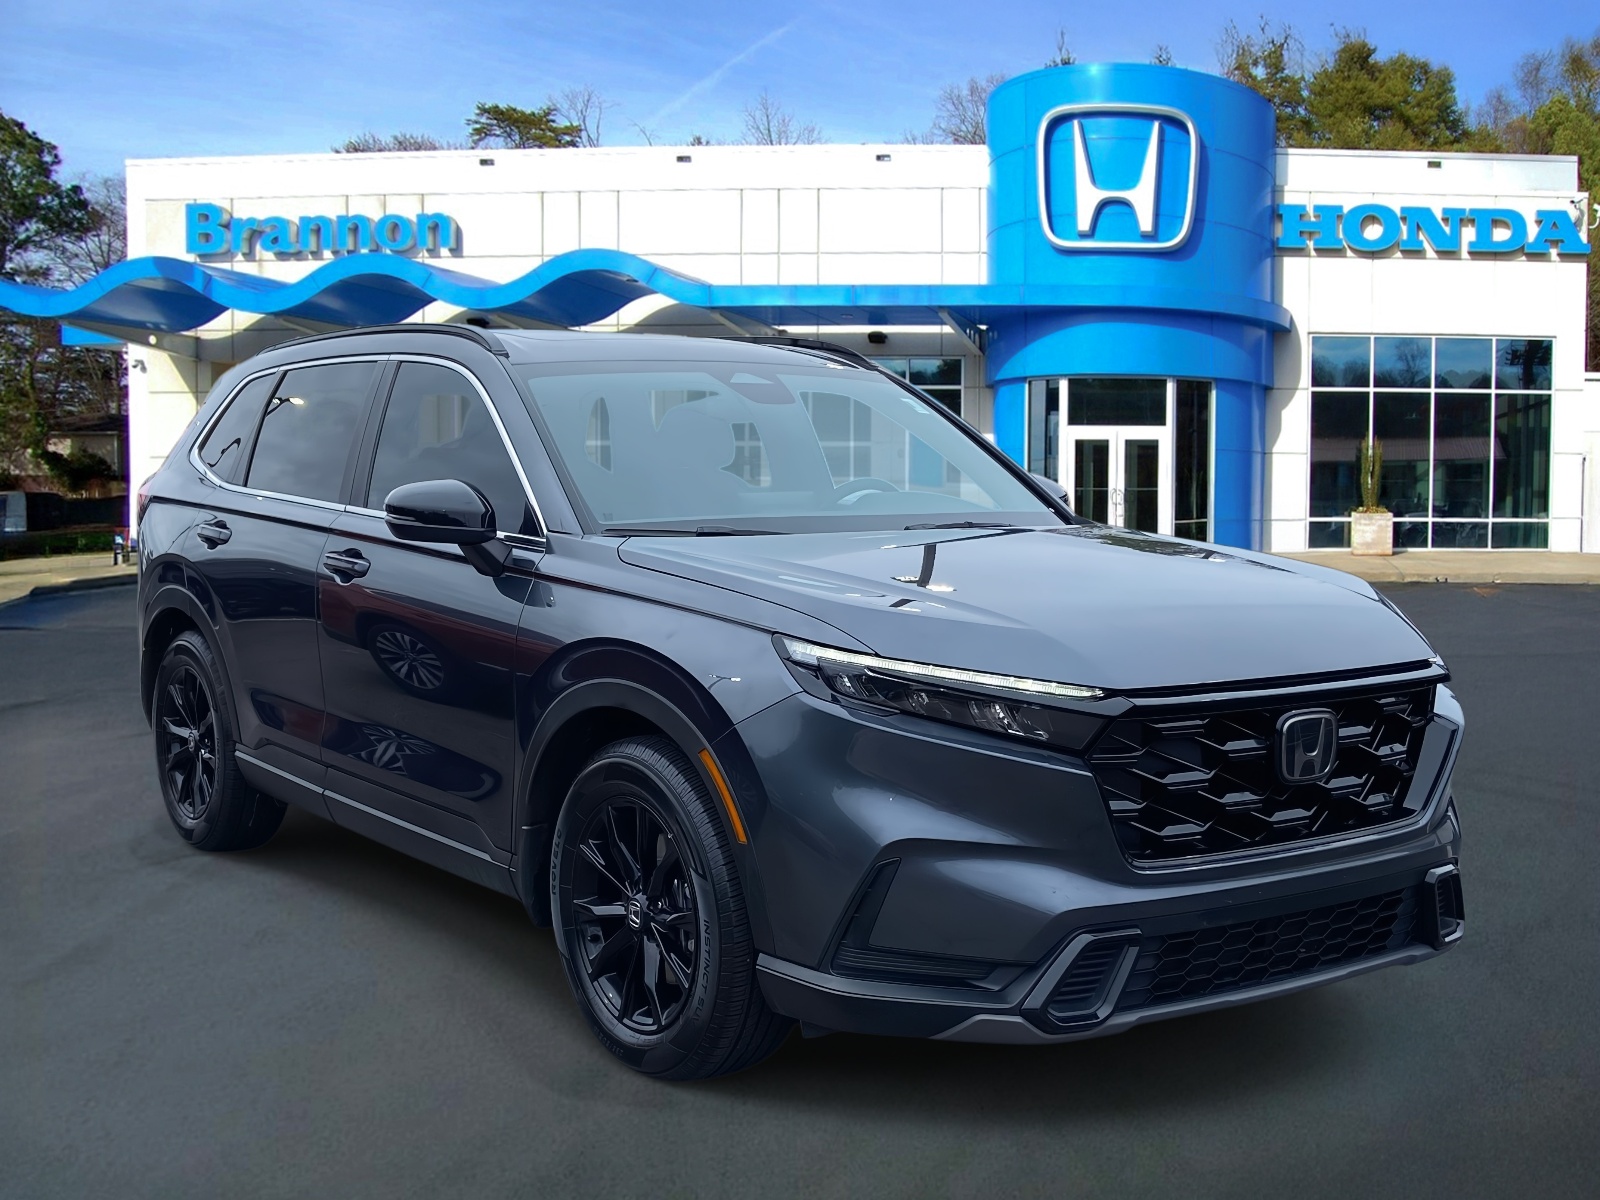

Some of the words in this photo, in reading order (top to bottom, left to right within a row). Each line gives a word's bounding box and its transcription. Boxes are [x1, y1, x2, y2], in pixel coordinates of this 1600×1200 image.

[185, 202, 458, 254] Brannon
[1276, 203, 1591, 254] HONDA
[551, 827, 563, 896] ROVELO
[702, 919, 711, 995] INSTINCT
